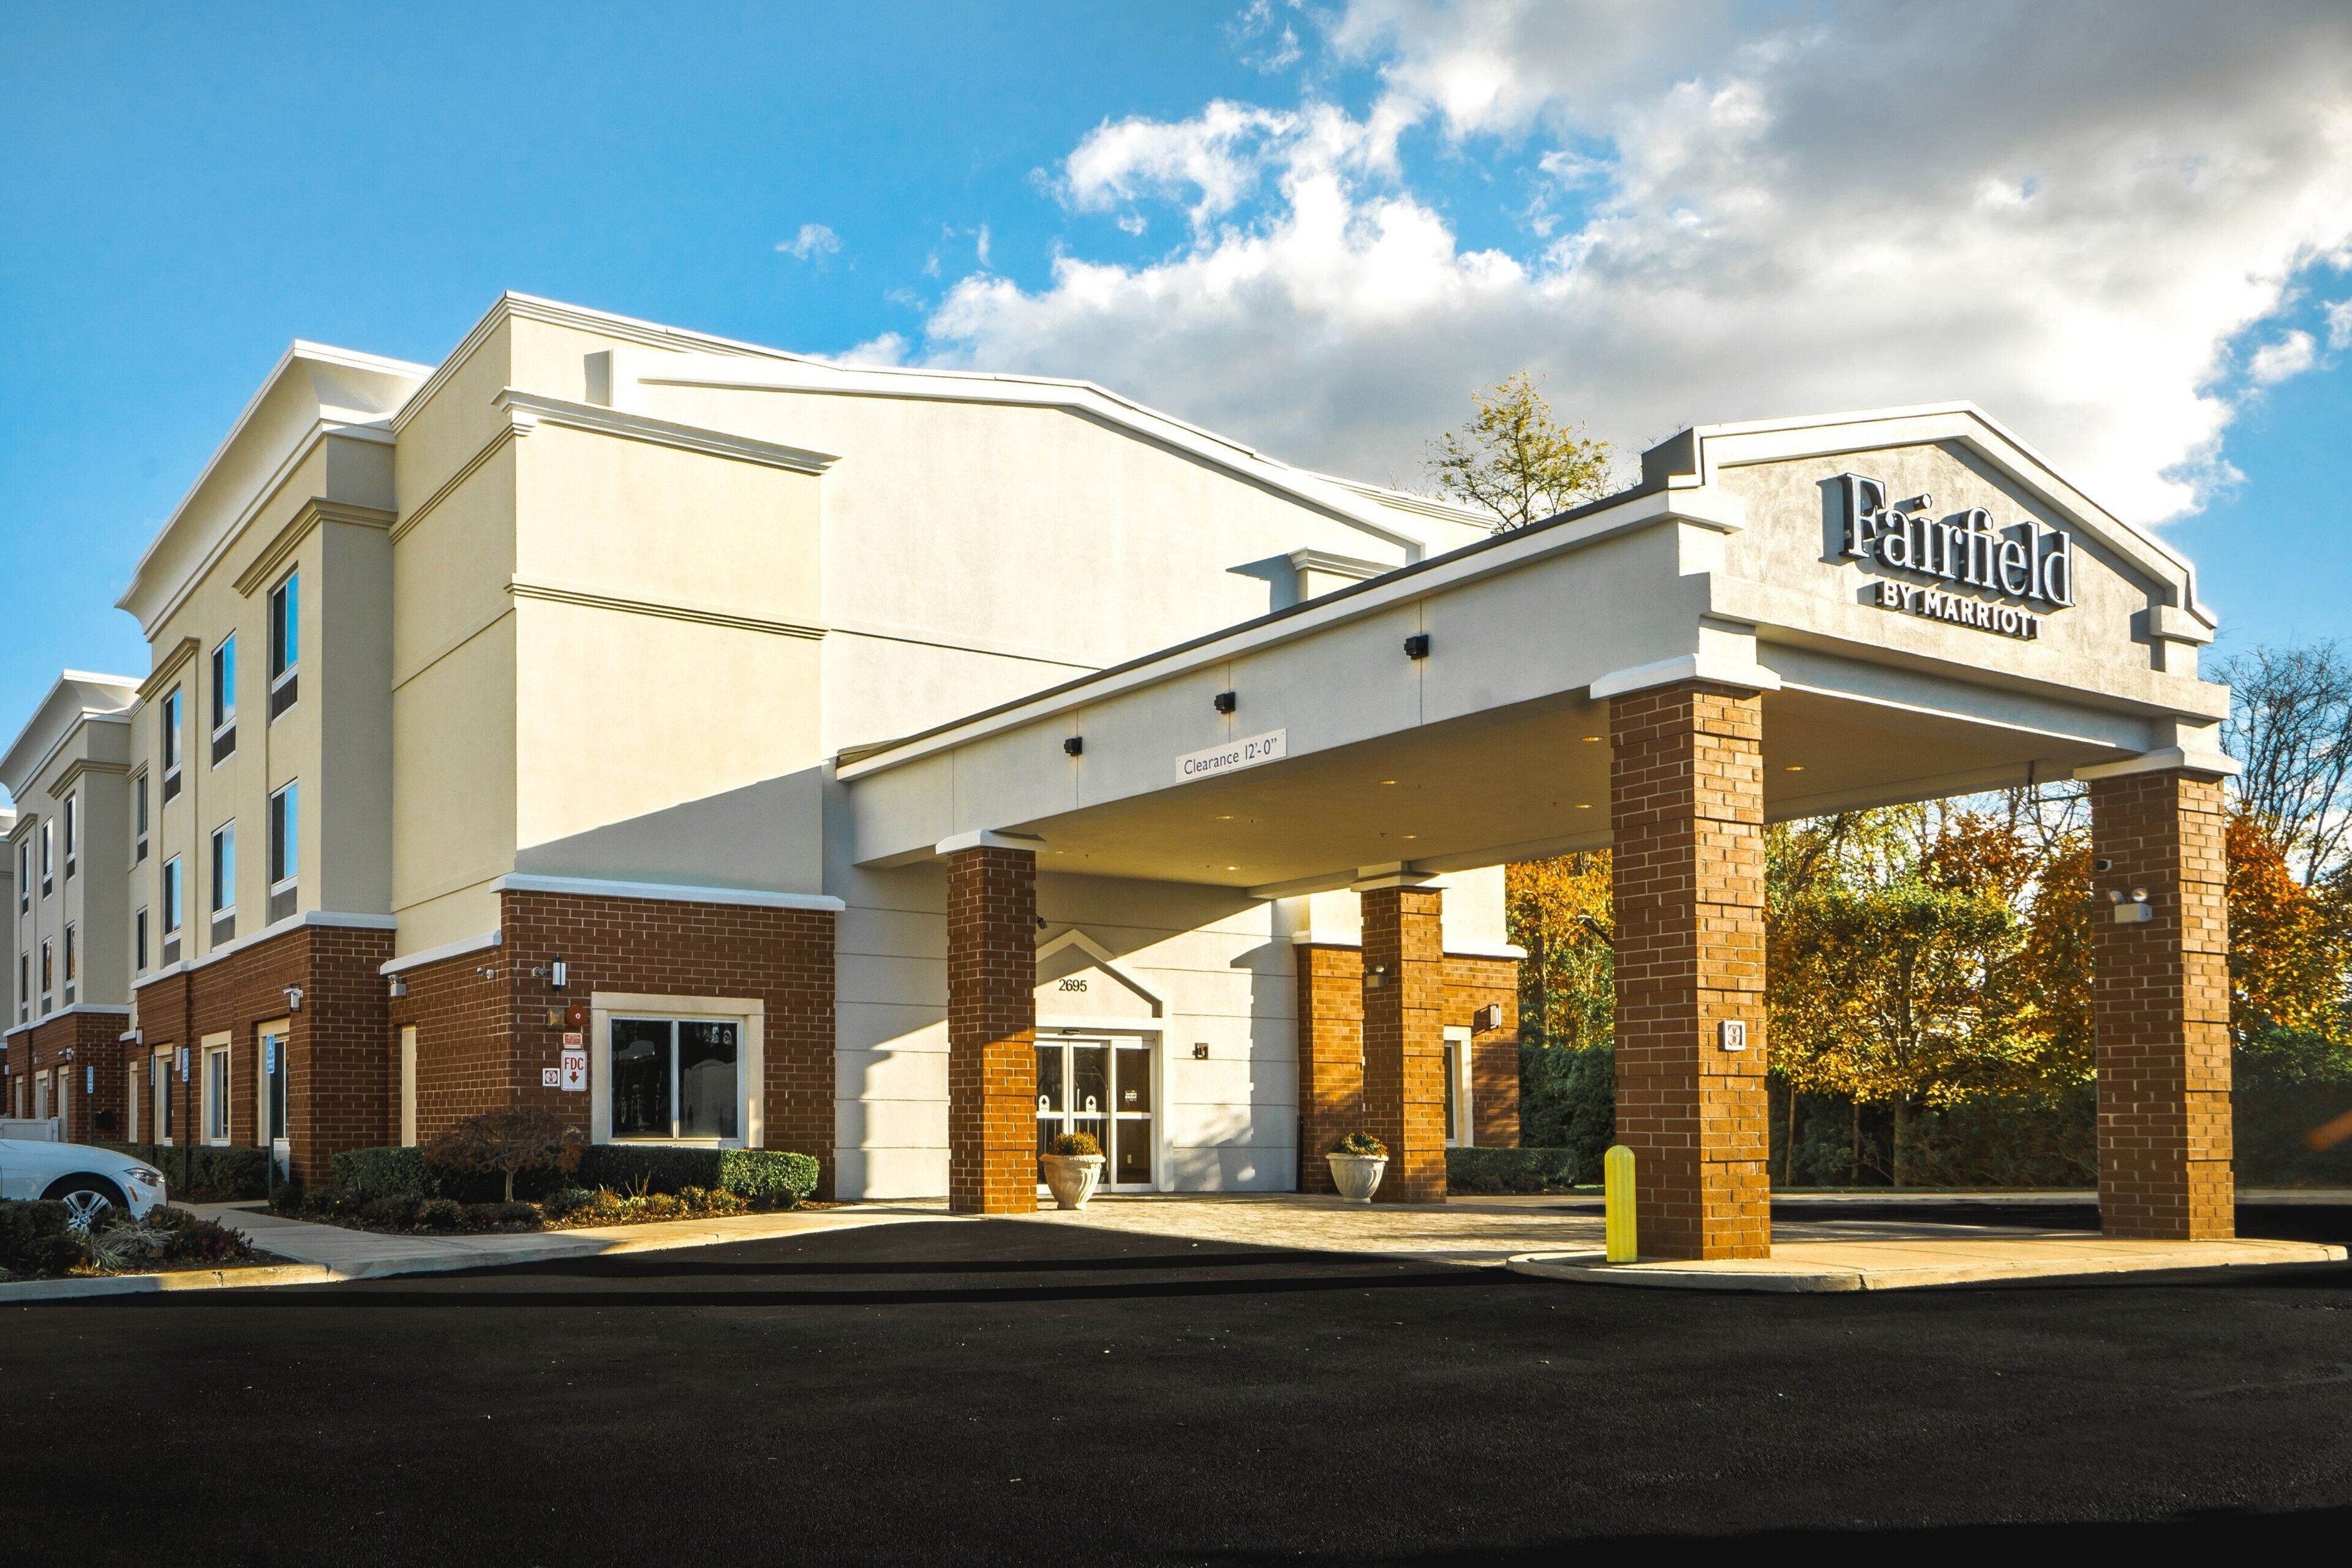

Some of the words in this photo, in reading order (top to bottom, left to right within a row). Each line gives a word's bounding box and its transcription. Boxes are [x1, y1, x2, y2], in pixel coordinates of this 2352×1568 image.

[1845, 472, 2076, 608] Fairfield
[1883, 581, 1914, 609] BY
[1924, 589, 2045, 639] MARRIOTT
[1184, 752, 1239, 774] Clearance
[1059, 979, 1087, 992] 2695
[564, 1057, 584, 1071] FDC
